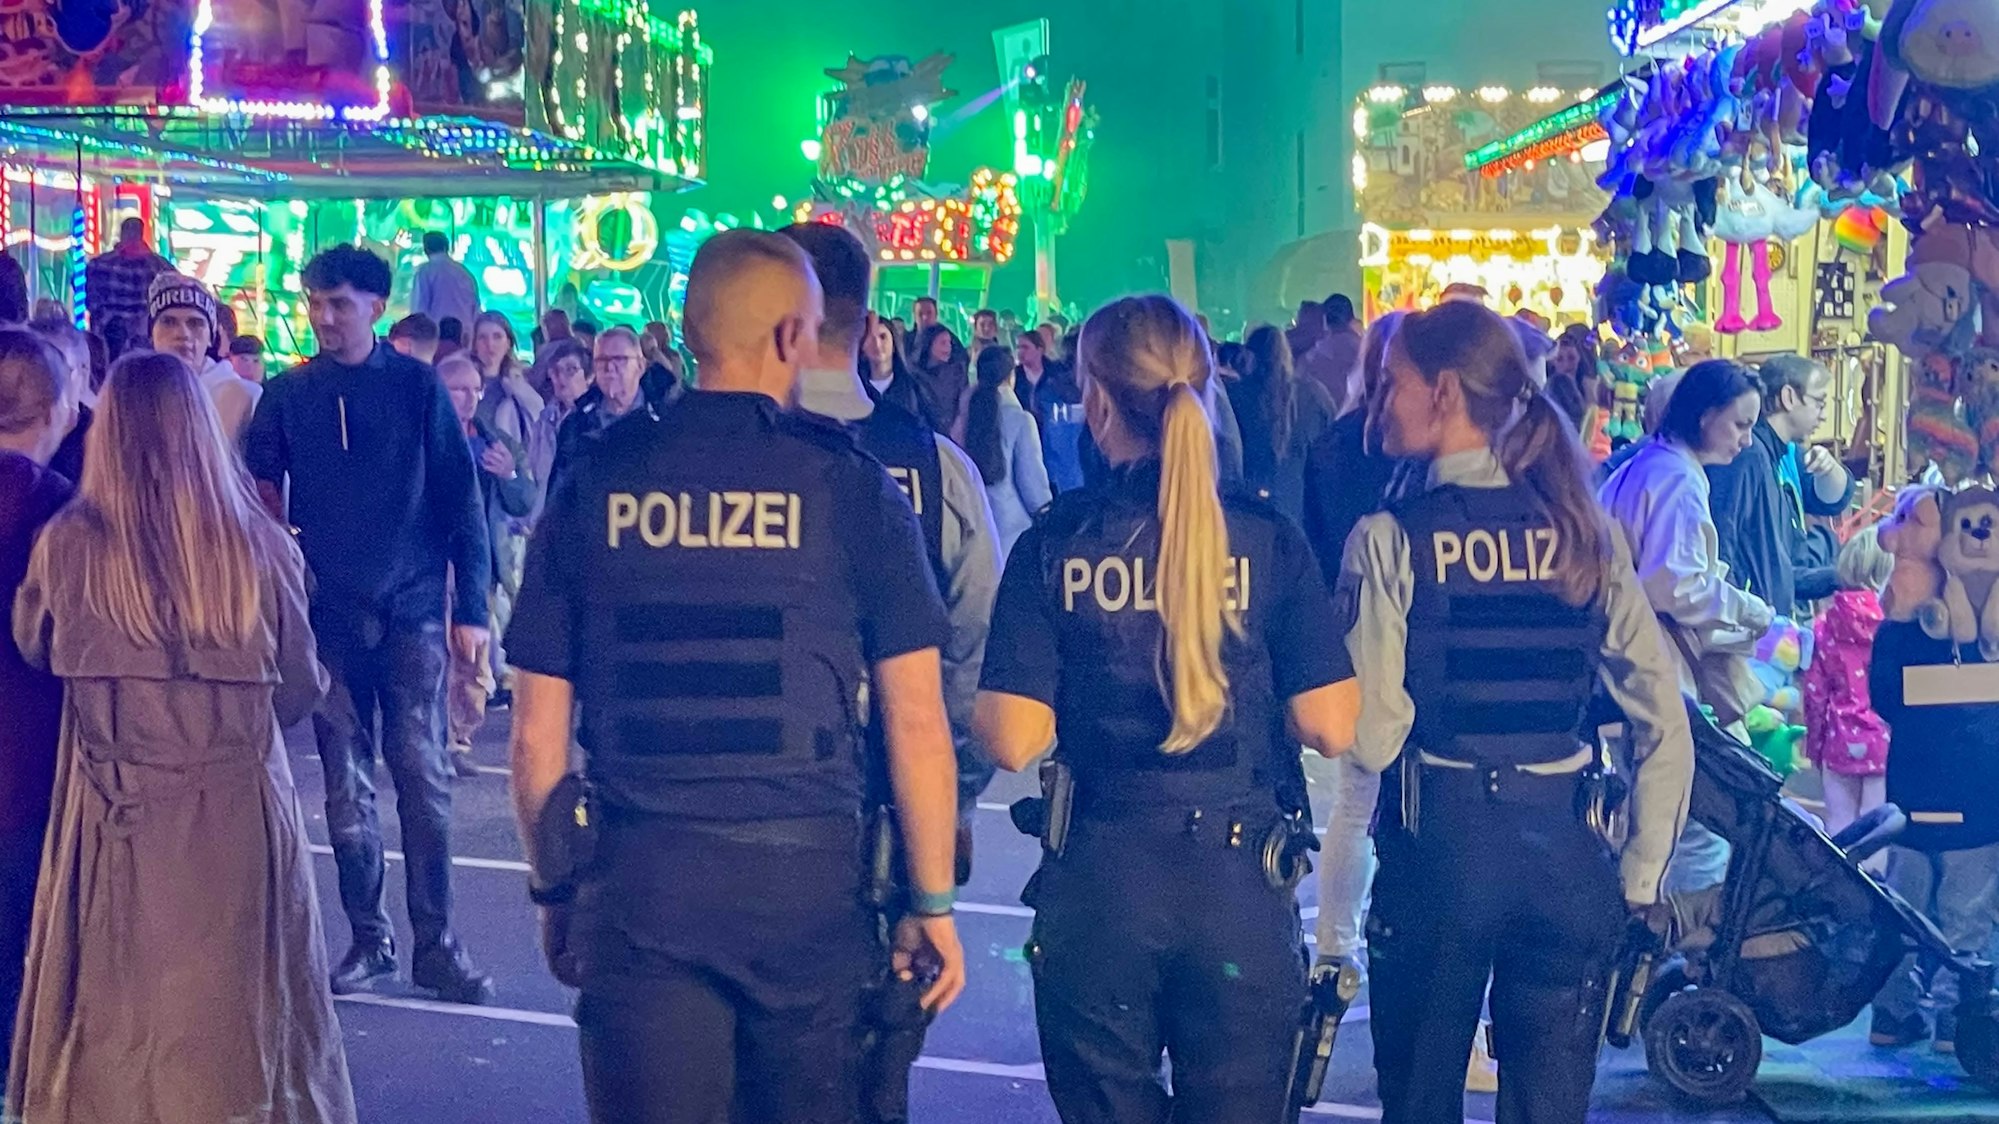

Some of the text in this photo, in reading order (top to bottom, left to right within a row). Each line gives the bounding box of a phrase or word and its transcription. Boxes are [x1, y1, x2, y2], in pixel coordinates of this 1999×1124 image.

[607, 490, 801, 549] POLIZEI
[1063, 556, 1250, 612] POLI
[1433, 528, 1560, 584] POLIZ
